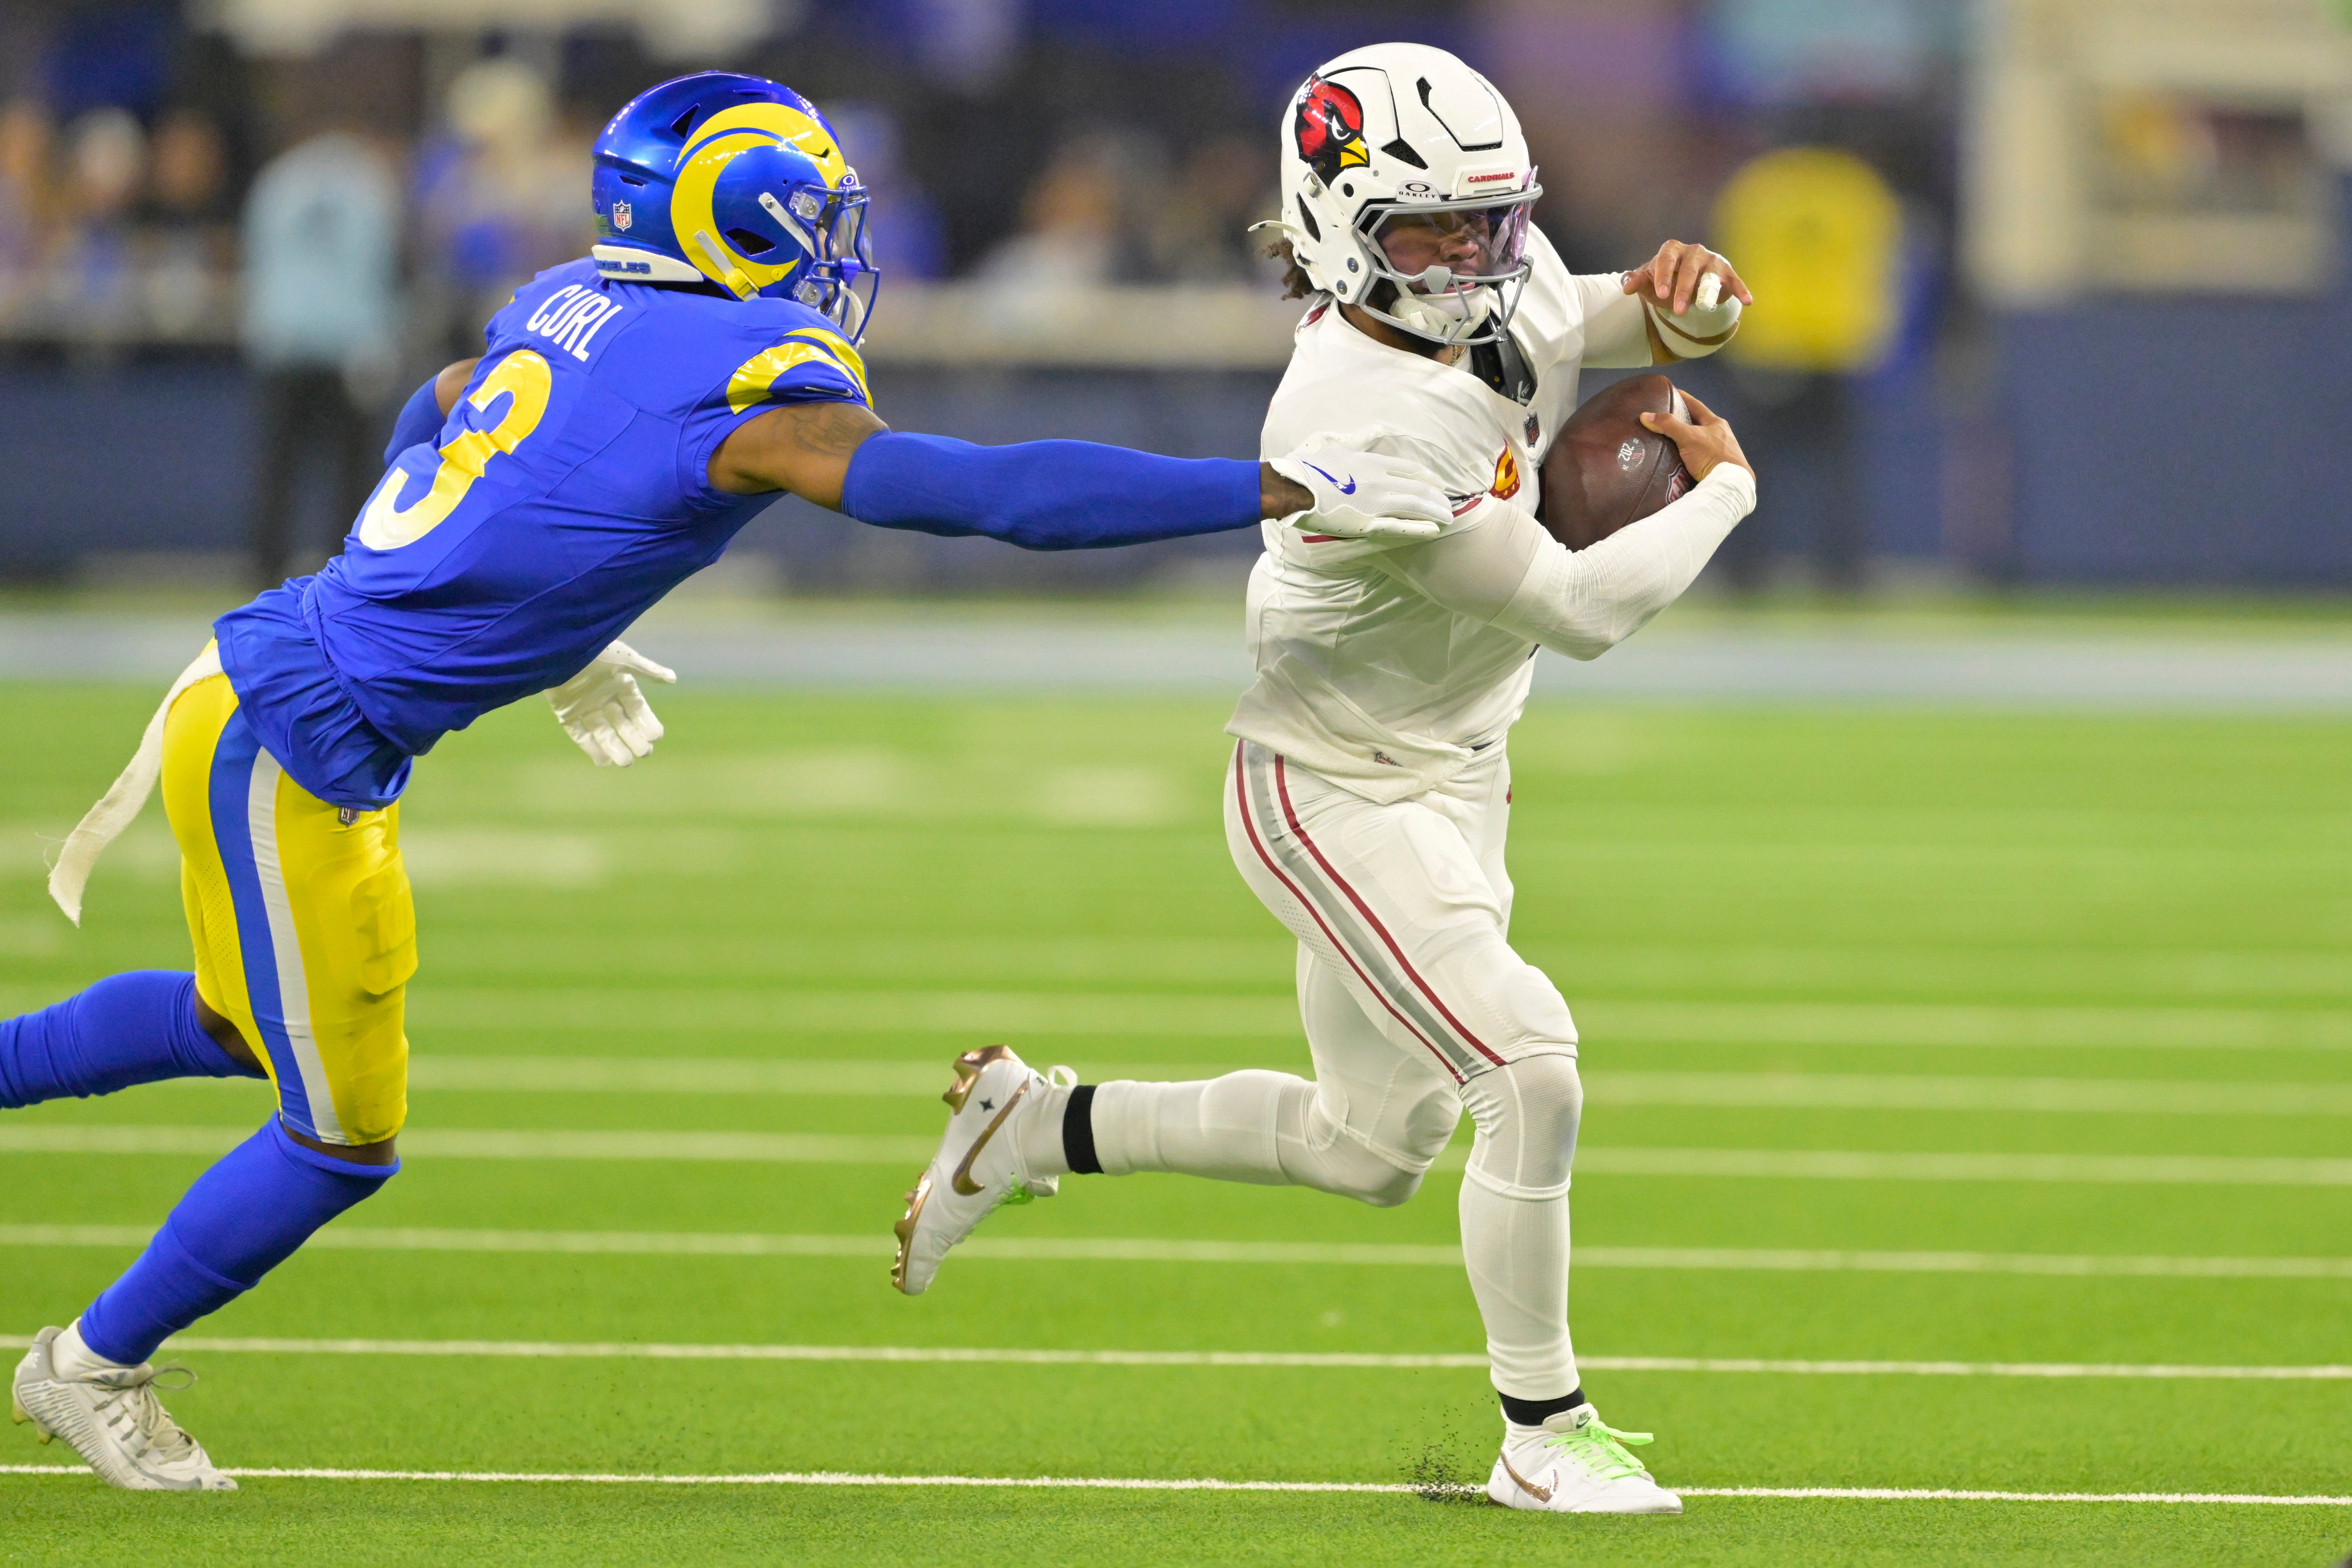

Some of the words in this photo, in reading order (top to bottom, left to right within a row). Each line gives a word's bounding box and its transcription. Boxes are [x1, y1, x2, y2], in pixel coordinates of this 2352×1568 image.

[1468, 172, 1515, 183] CARDINALS
[616, 214, 630, 226] NFL
[527, 284, 623, 362] CURL
[359, 349, 552, 550] 3
